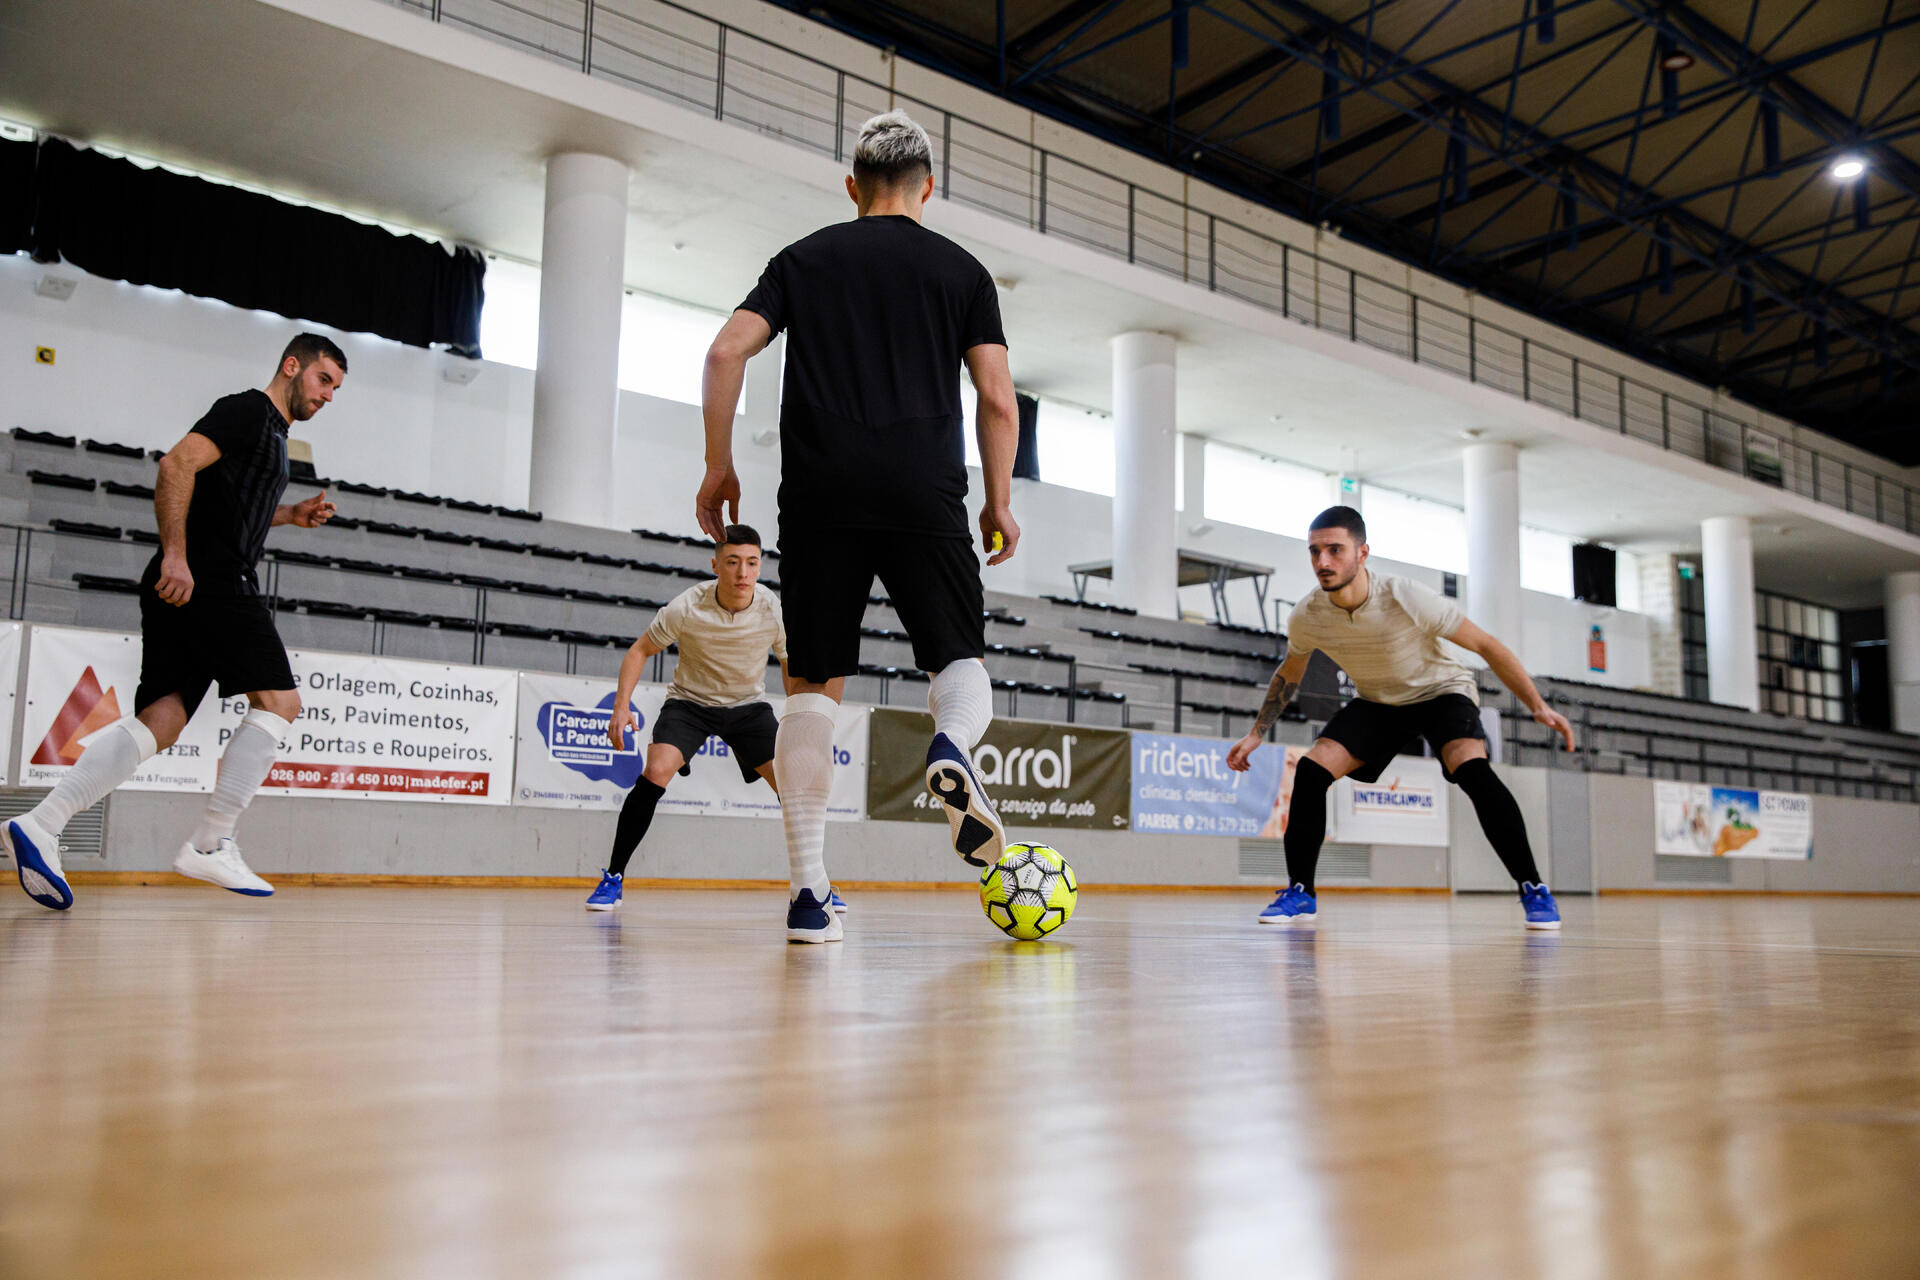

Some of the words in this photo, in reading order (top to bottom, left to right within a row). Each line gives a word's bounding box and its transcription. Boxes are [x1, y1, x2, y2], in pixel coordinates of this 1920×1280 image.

[309, 672, 402, 699] Orlagem,
[410, 681, 498, 706] Cozinhas,
[345, 706, 469, 734] Pavimentos,
[301, 734, 366, 754] Portas
[373, 742, 384, 755] e
[391, 740, 493, 762] Roupeiros.
[555, 732, 564, 744] &
[973, 735, 1072, 789] arral
[271, 769, 294, 781] 926
[297, 770, 321, 783] 900
[331, 772, 354, 784] 214
[357, 773, 380, 786] 450
[1000, 798, 1046, 819] serviço
[1049, 799, 1067, 815] da
[1065, 800, 1096, 818] pele
[1353, 790, 1433, 808] INTERCAMPUS
[1138, 812, 1180, 829] PAREDE
